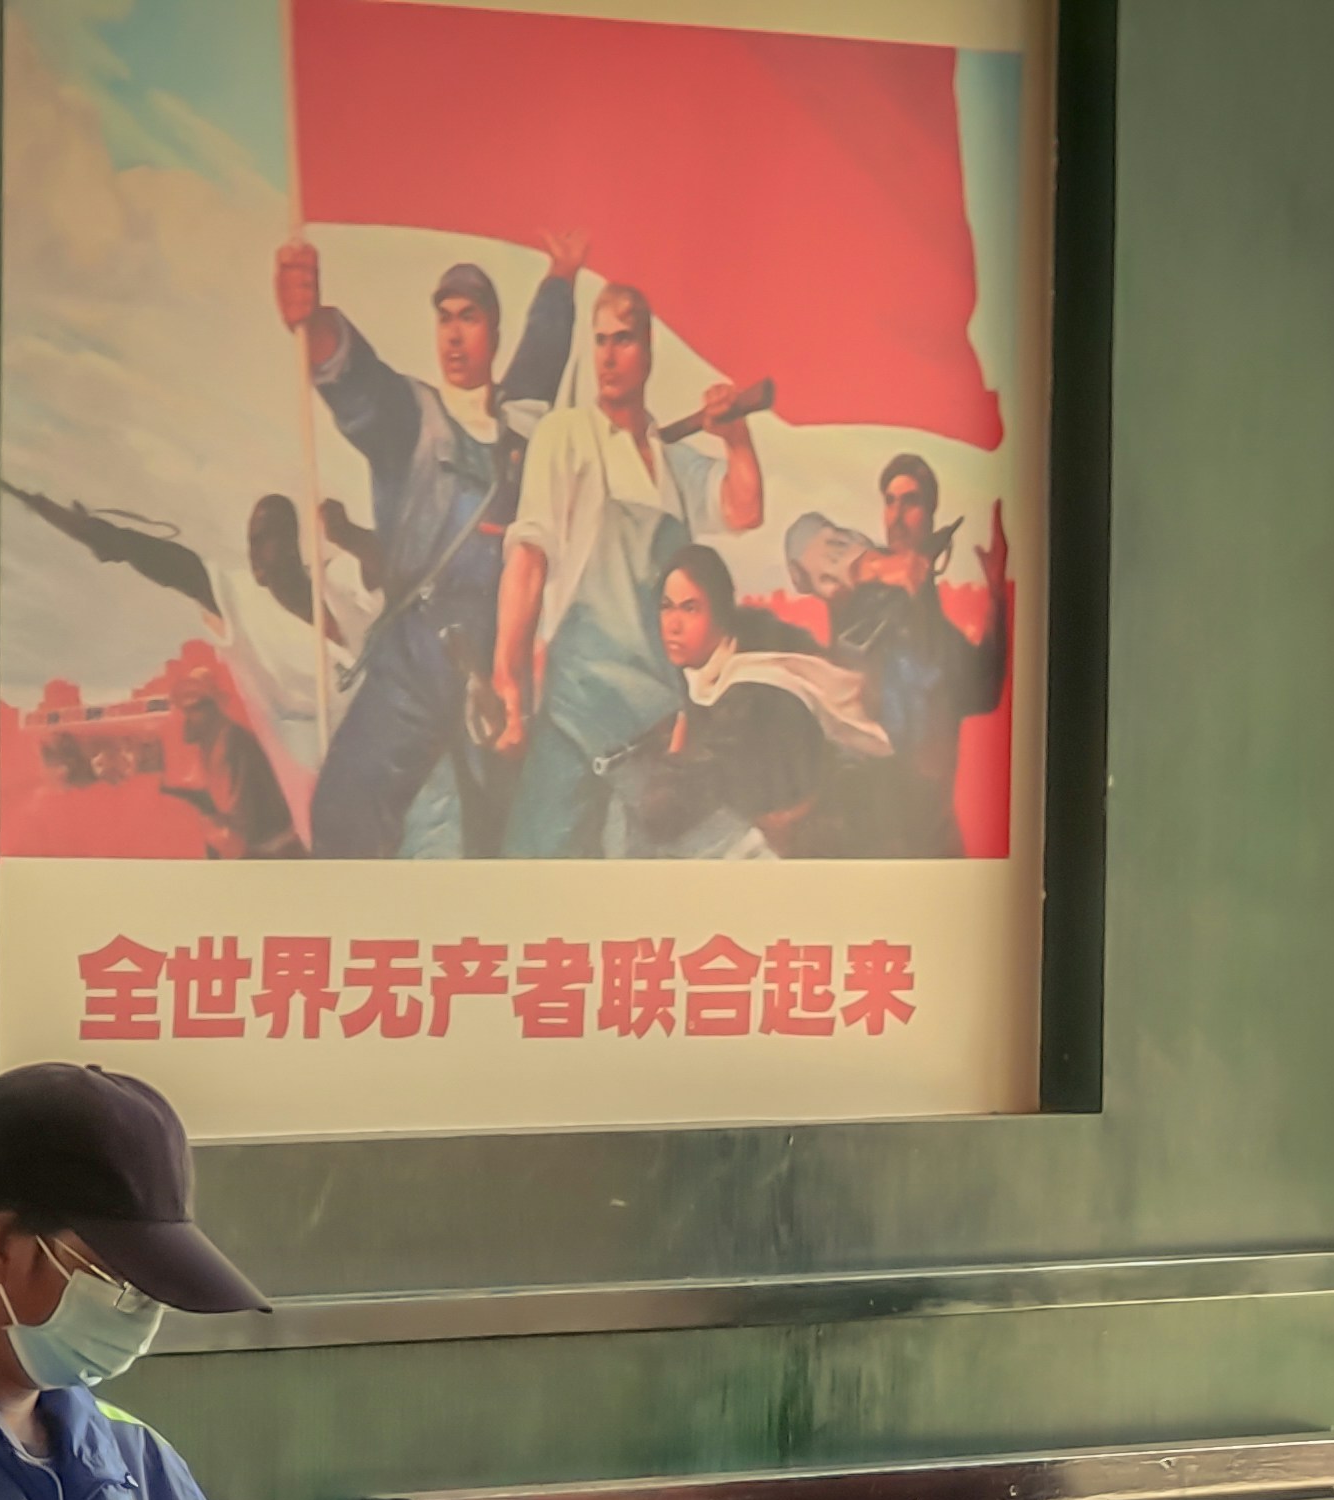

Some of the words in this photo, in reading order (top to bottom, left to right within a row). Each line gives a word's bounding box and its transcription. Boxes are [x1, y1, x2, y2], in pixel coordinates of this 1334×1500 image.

[78, 932, 917, 1040] 全世界无产者联合起来
